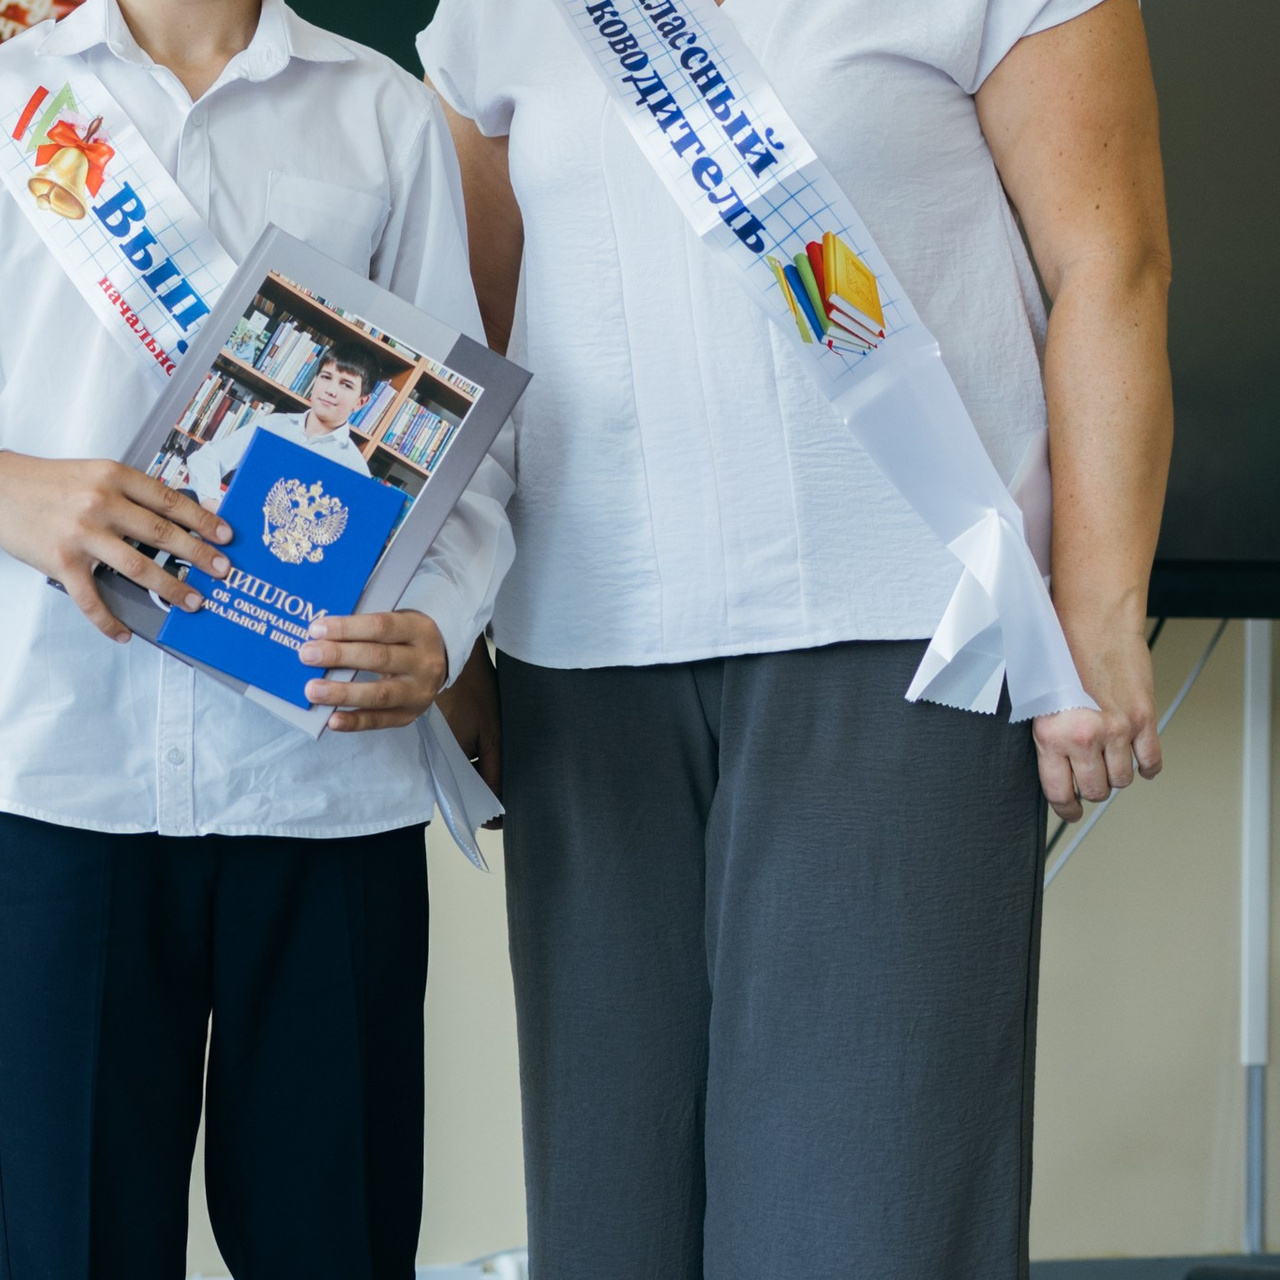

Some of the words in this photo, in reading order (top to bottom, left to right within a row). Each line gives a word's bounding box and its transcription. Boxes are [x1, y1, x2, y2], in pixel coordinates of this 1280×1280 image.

[91, 180, 211, 356] Вып
[211, 567, 329, 622] ДИПЛОМ
[212, 588, 232, 603] ОБ
[234, 598, 310, 641] ОКОНЧАНИИ
[201, 596, 267, 636] АЧАЛЬНОЙ
[269, 629, 302, 652] ШКО
